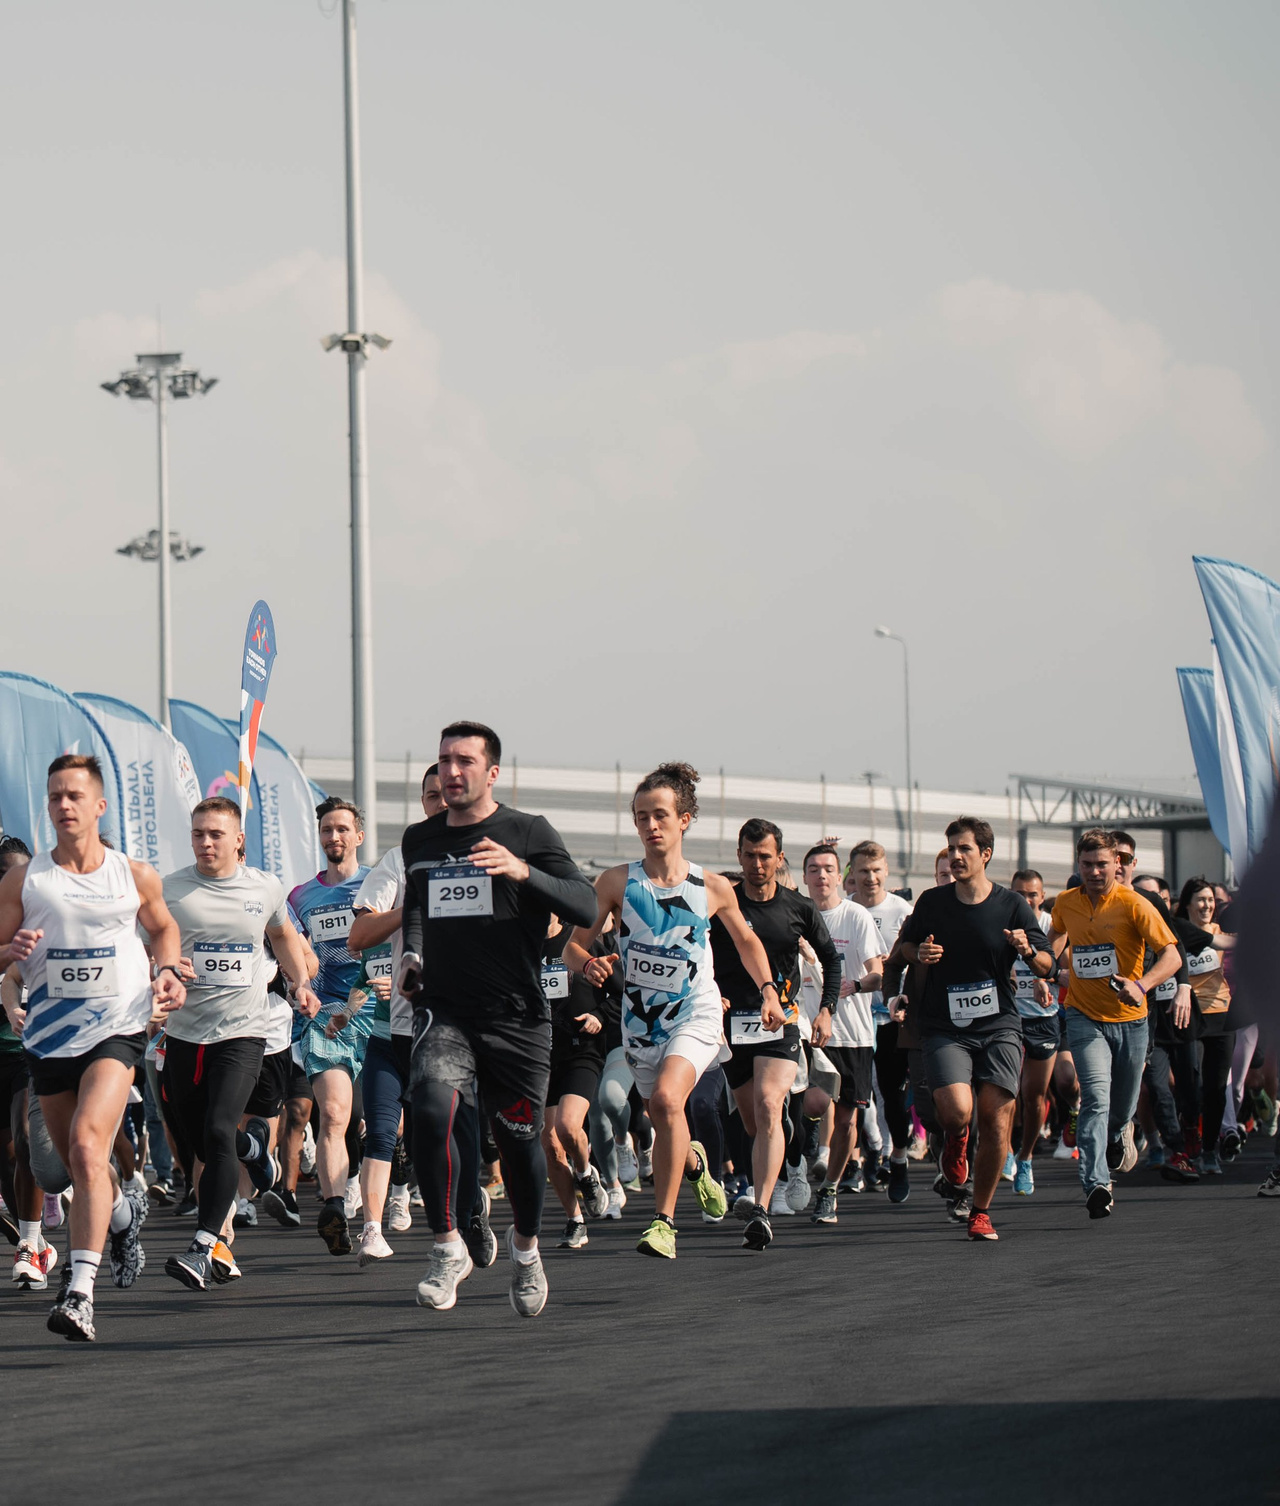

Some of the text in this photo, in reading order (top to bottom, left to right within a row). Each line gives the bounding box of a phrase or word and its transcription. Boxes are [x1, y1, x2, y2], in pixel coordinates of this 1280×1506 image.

[440, 885, 479, 902] 299
[319, 916, 347, 930] 1811
[205, 959, 242, 972] 954
[632, 958, 677, 978] 1087
[1077, 955, 1111, 968] 1249
[1189, 954, 1213, 968] 648
[61, 967, 103, 982] 657
[956, 994, 992, 1009] 1106
[741, 1021, 768, 1033] 77
[495, 1111, 533, 1133] Reebok
